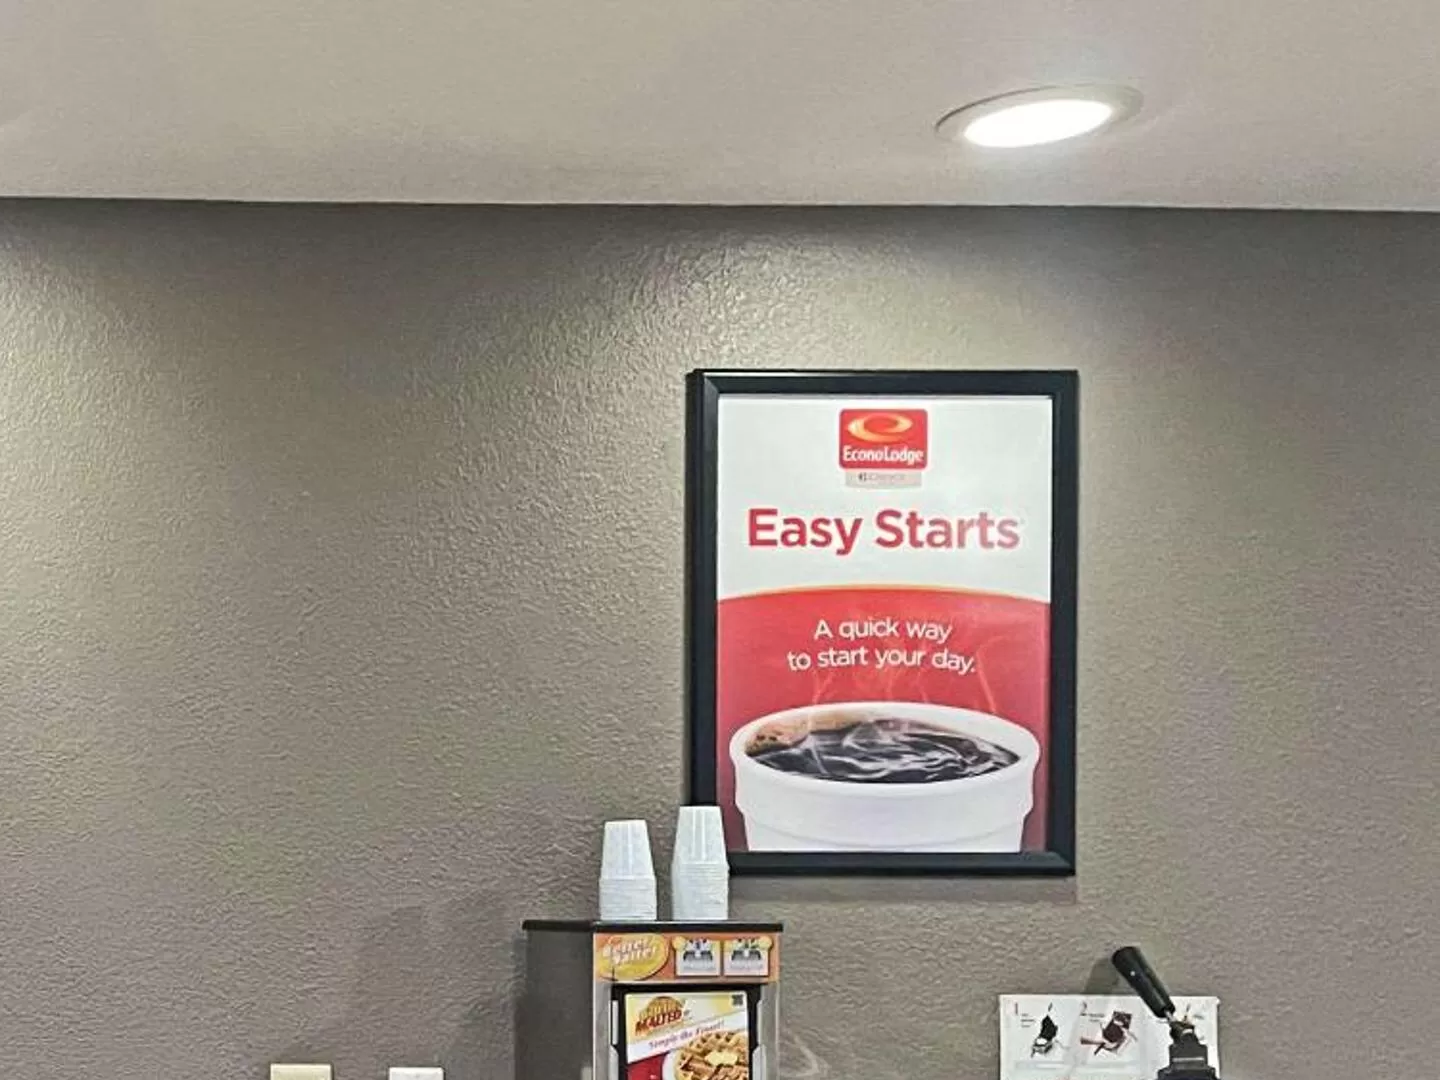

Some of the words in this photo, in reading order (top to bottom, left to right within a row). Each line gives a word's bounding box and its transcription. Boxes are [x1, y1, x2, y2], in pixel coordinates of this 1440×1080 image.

[748, 508, 863, 555] Easy
[875, 509, 1021, 549] Starts
[814, 620, 833, 640] A
[839, 617, 900, 642] quick
[906, 621, 954, 645] way
[787, 652, 811, 671] to
[817, 646, 868, 668] start
[875, 649, 925, 671] your
[931, 649, 977, 674] day.
